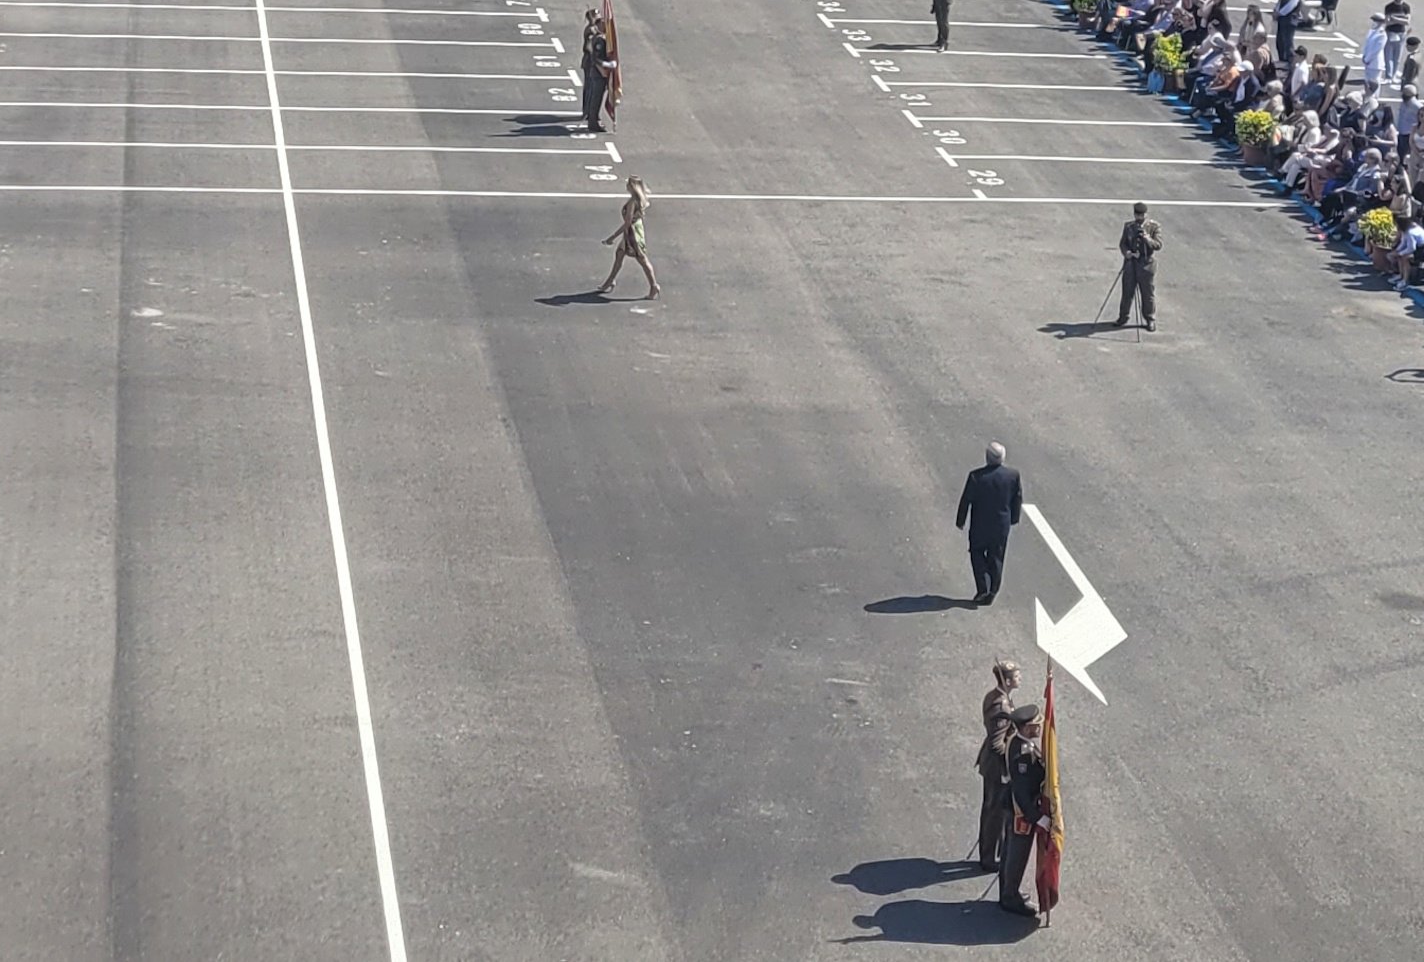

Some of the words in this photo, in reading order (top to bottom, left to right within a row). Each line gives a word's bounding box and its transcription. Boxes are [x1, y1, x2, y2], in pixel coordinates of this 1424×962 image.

[817, 1, 846, 12] 34
[517, 23, 544, 35] 80
[842, 29, 872, 41] 33
[533, 56, 561, 67] 81
[869, 59, 900, 72] 32
[548, 88, 577, 101] 82
[900, 93, 932, 106] 31
[933, 130, 967, 144] 30
[584, 165, 618, 180] 84
[967, 169, 1004, 185] 29
